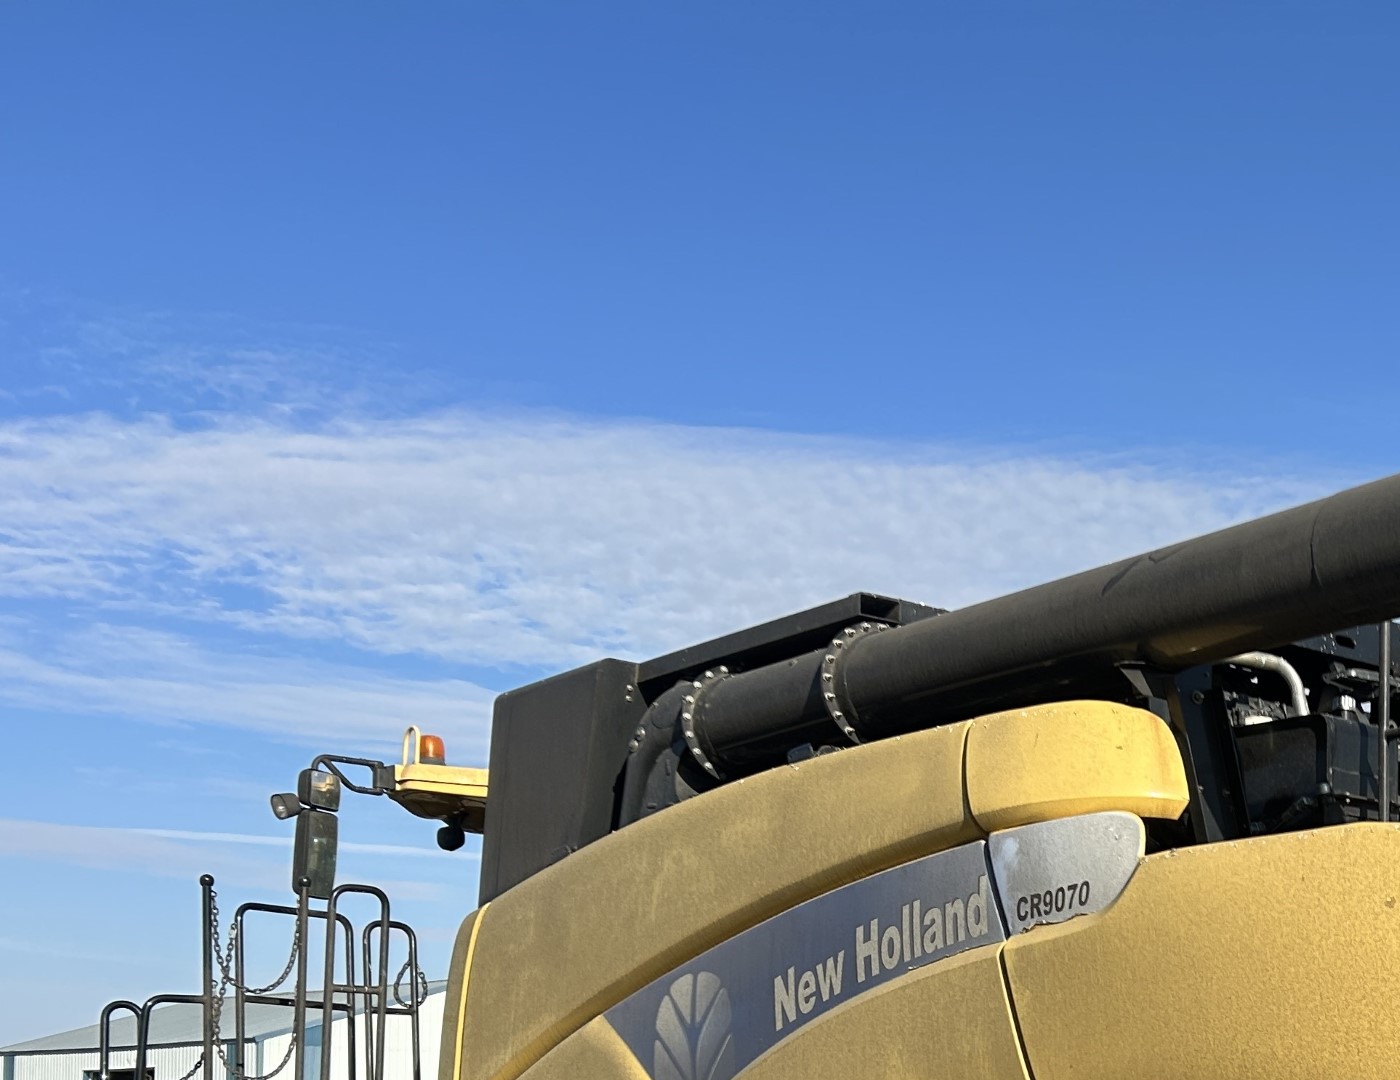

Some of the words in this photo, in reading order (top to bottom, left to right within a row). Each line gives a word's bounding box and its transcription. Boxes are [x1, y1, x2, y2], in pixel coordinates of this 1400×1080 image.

[1016, 880, 1090, 922] CR9070
[772, 950, 845, 1032] New
[855, 874, 989, 983] Holland
